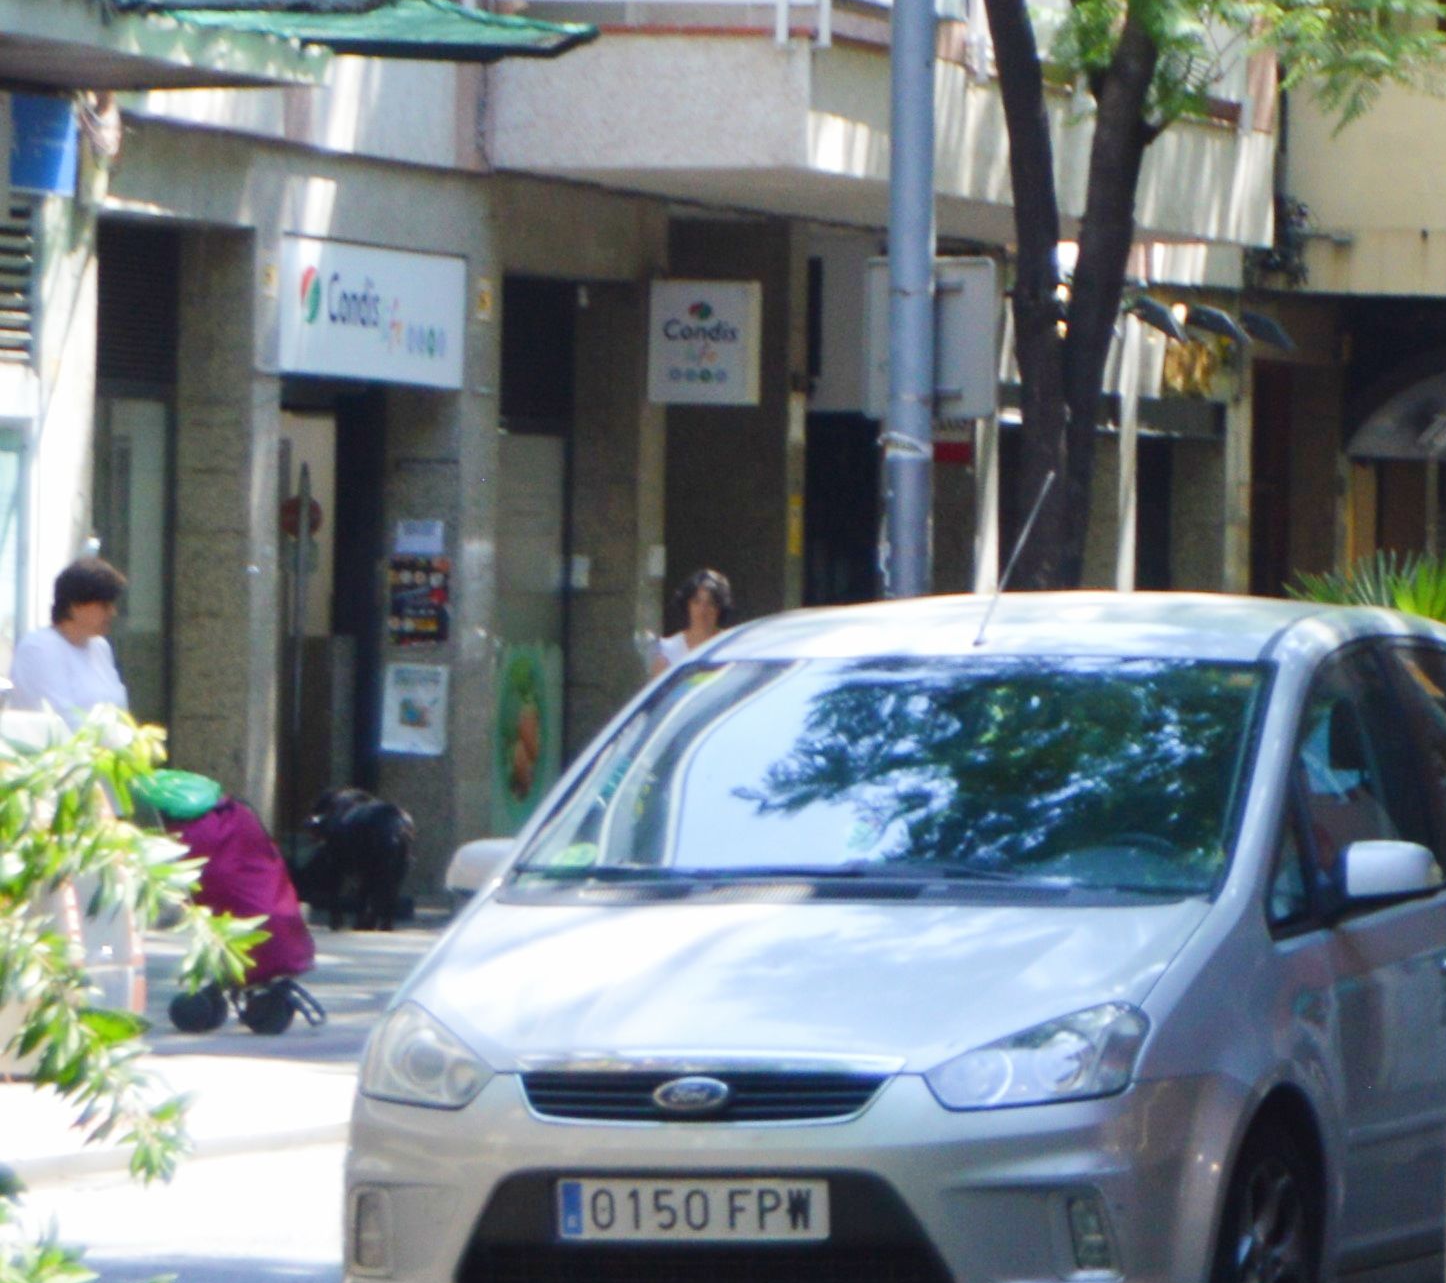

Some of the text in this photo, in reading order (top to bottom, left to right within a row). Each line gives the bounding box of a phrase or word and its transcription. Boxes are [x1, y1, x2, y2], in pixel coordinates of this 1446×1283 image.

[663, 318, 738, 342] Condis
[590, 1188, 812, 1231] 0150 FPW
